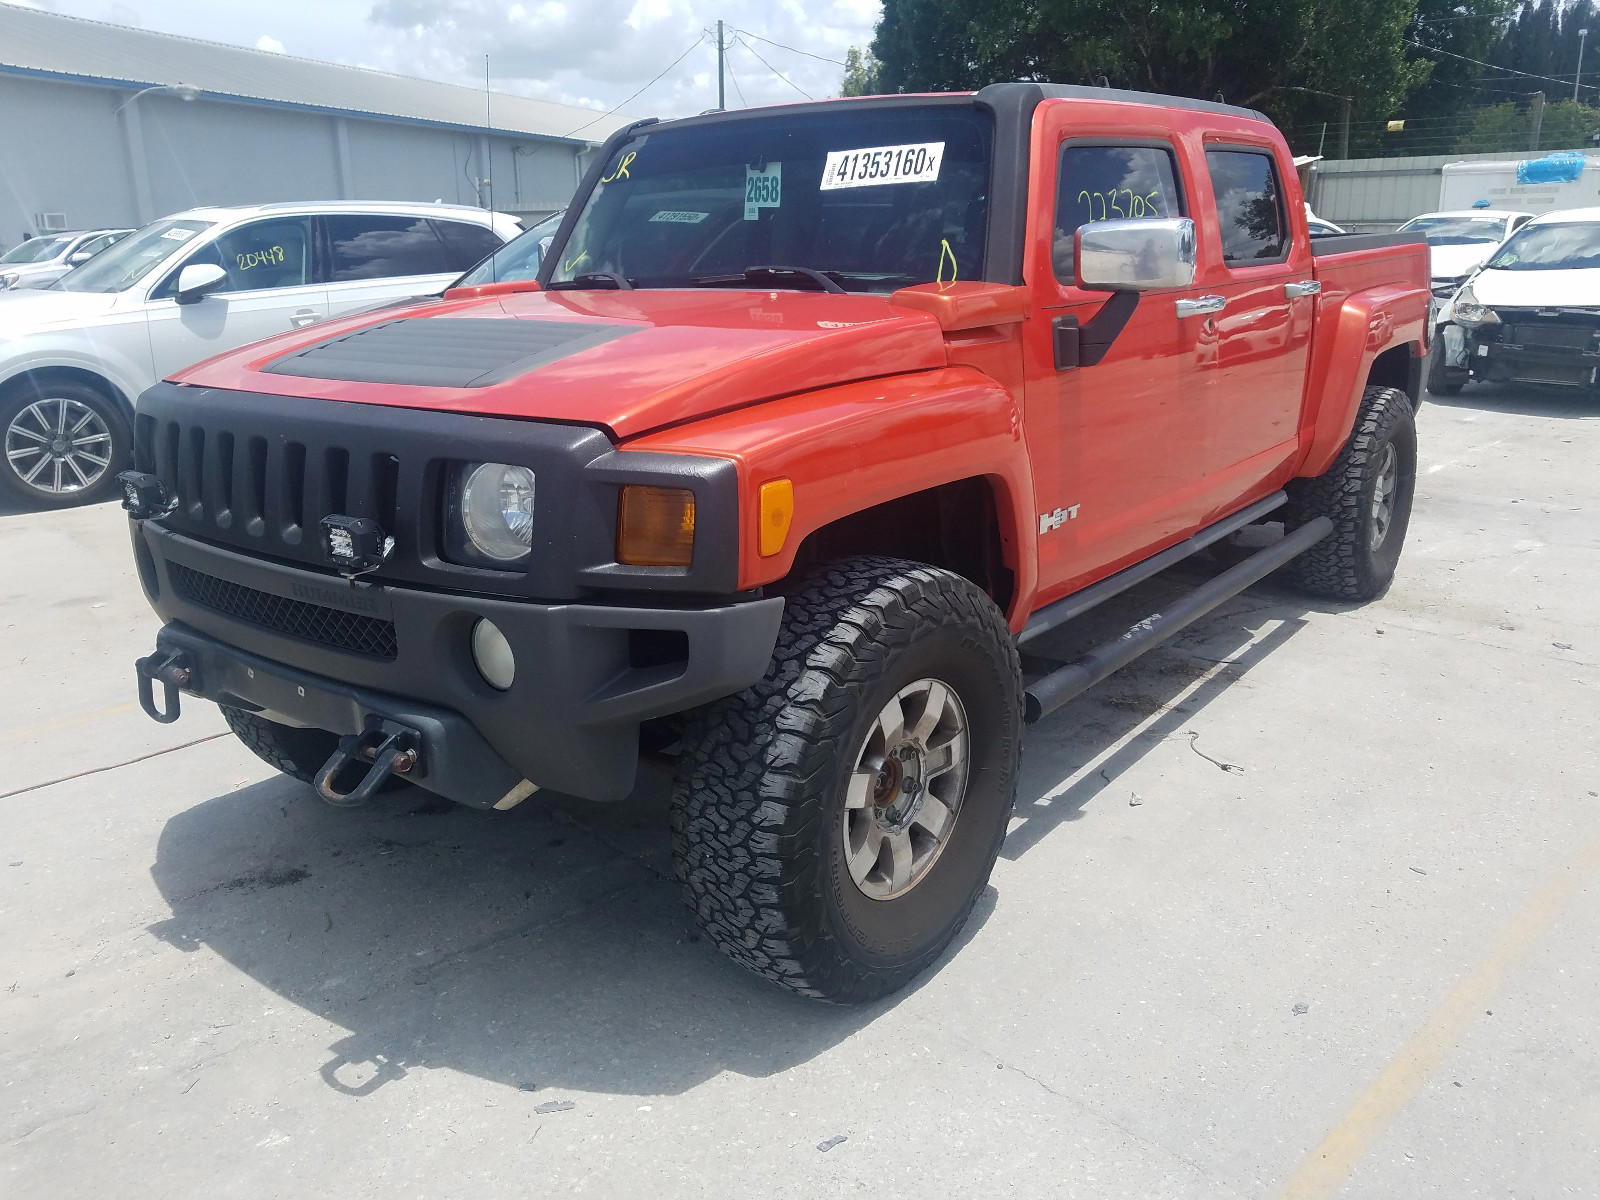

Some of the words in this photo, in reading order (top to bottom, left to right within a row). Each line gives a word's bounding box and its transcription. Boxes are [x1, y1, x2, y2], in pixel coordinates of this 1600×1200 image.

[746, 175, 779, 203] 2658
[236, 245, 284, 271] 20448
[1039, 503, 1081, 535] H3T
